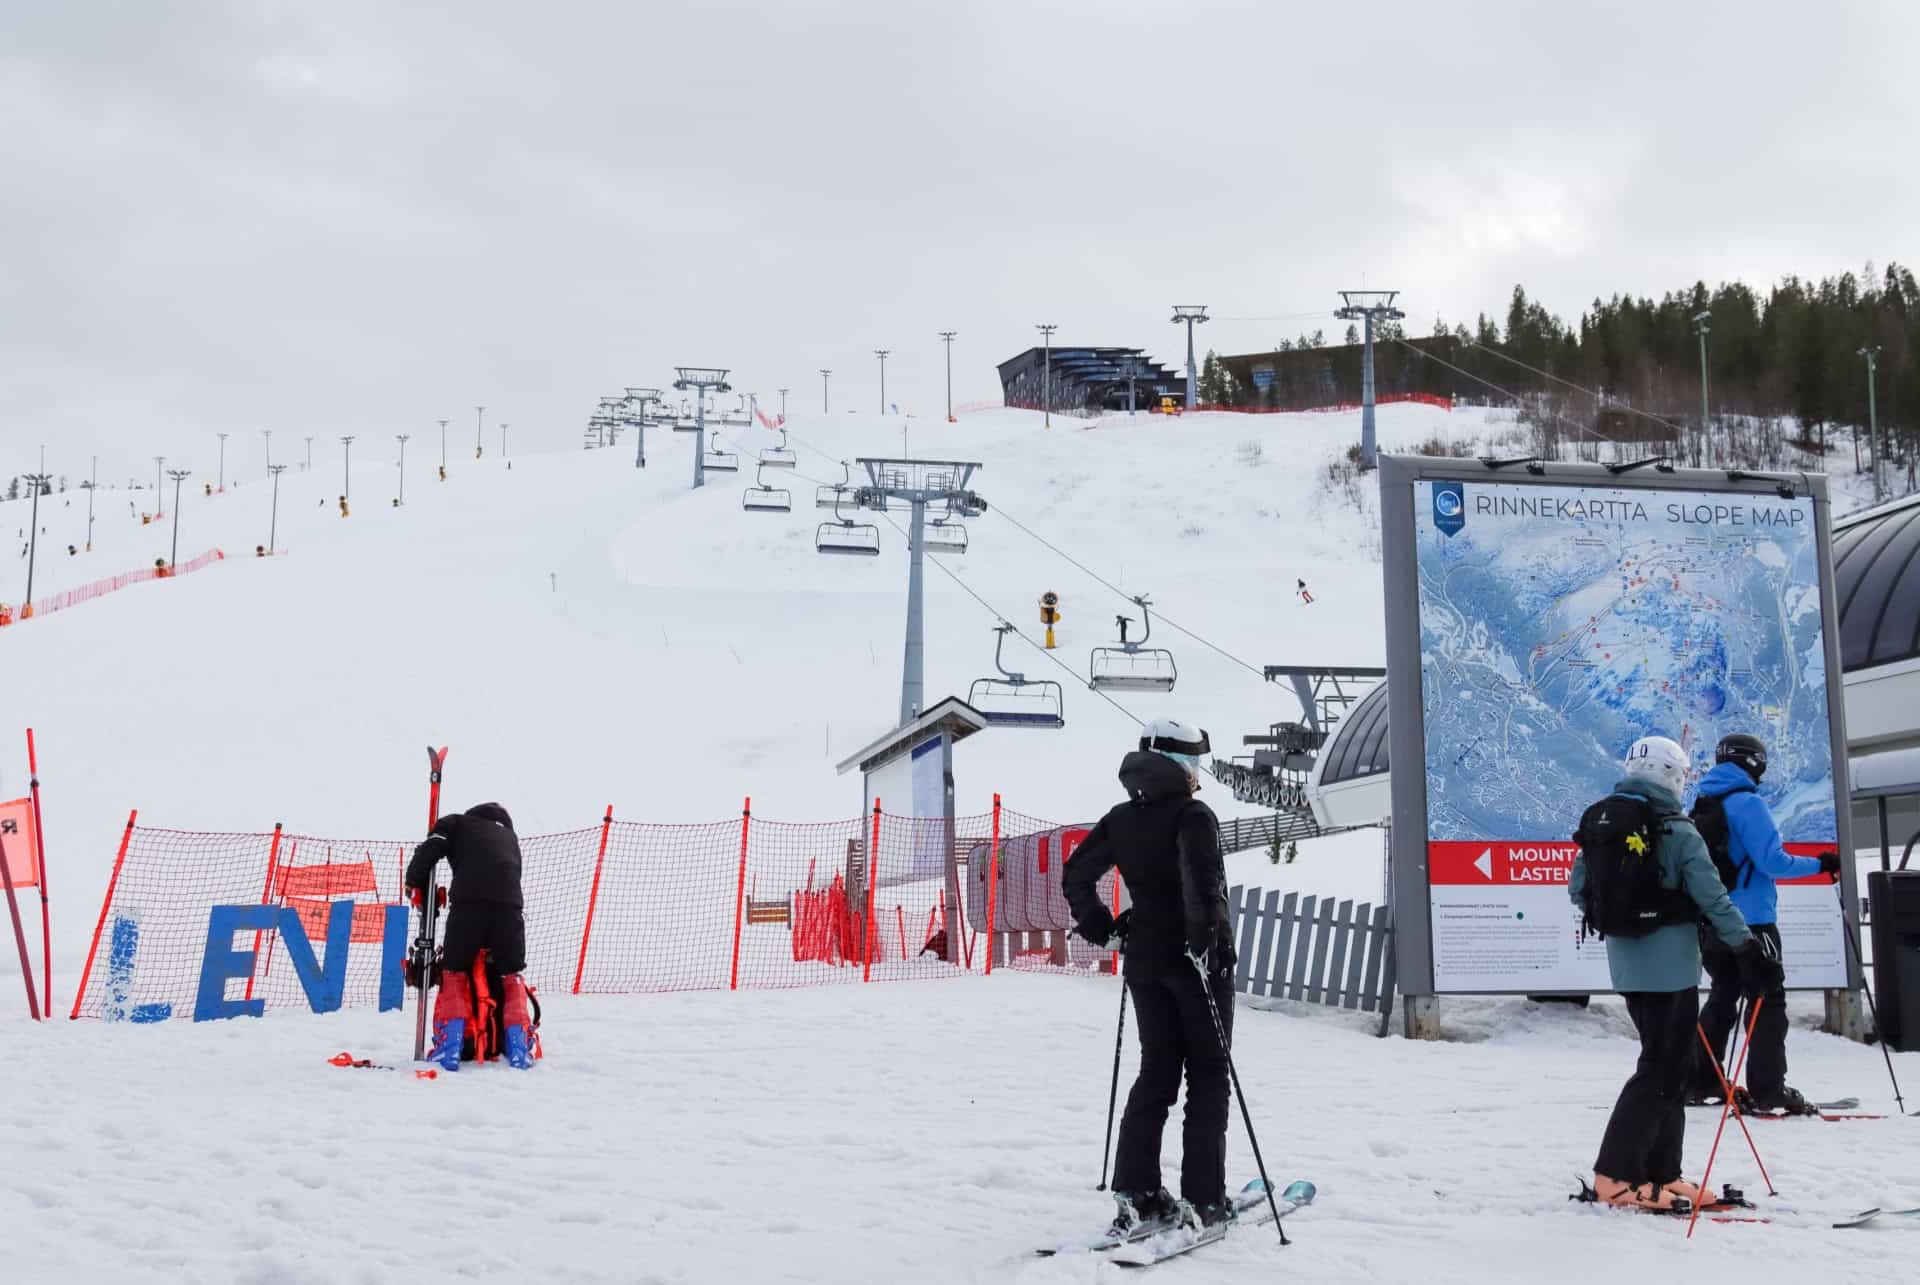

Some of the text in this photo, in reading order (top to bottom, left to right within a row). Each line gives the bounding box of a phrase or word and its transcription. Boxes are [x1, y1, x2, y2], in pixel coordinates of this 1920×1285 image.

[1476, 495, 1649, 522] RINNEKARTTA
[1666, 503, 1745, 526] SLOPE
[1751, 507, 1805, 528] MAP
[102, 900, 410, 1024] LEVI
